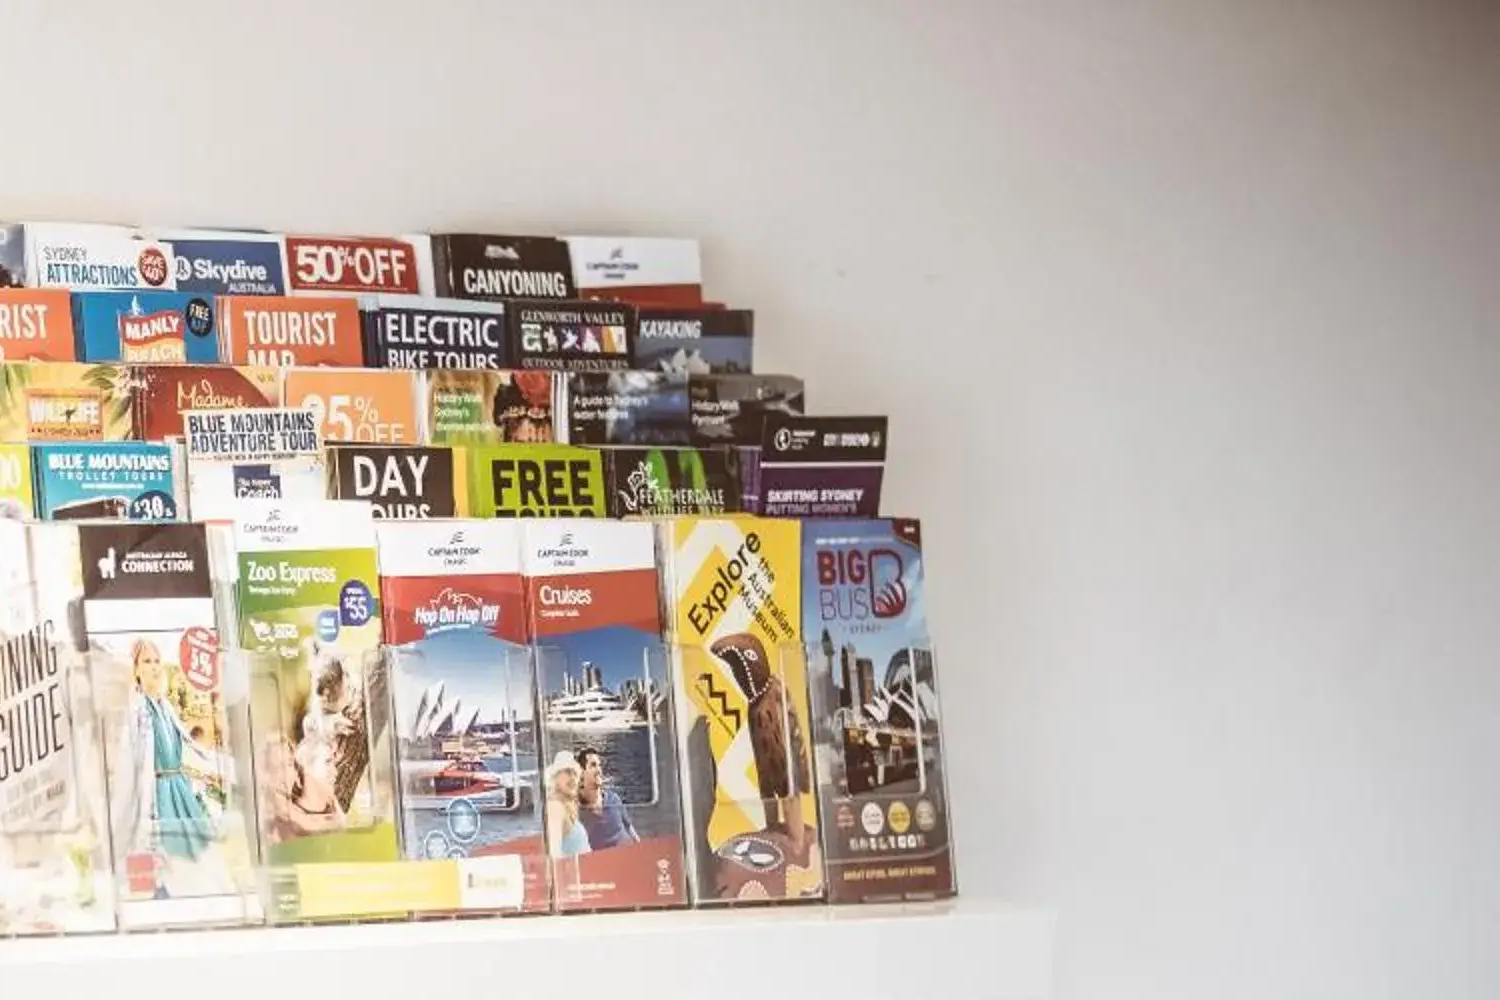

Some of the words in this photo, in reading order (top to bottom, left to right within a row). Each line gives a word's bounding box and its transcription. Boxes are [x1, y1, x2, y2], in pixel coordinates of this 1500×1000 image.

[44, 247, 87, 261] SYDNEY
[47, 264, 137, 286] ATTRACTIONS
[195, 259, 267, 287] Skydive
[355, 248, 406, 285] OFF
[228, 283, 276, 294] AUSTRALIA
[464, 268, 567, 296] CANYONING
[125, 315, 179, 340] MANLY
[244, 310, 337, 345] TOURIST
[521, 311, 581, 324] GLENWORTH
[583, 312, 624, 324] VALLEY
[386, 314, 499, 348] ELECTRIC
[640, 320, 702, 338] KAYAKING
[388, 350, 429, 368] BIKE
[437, 352, 498, 368] TOURS
[189, 415, 225, 434] BLUE
[231, 412, 315, 433] MOUNTAINS
[355, 422, 404, 442] OFF
[191, 433, 276, 452] ADVENTURE
[280, 431, 317, 451] TOUR
[49, 452, 84, 471] BLUE
[88, 453, 170, 471] MOUNTAINS
[353, 455, 429, 497] DAY
[492, 460, 594, 506] FREE
[237, 486, 282, 499] Coach
[639, 488, 724, 504] FEATHERDALE
[820, 489, 863, 502] SYDNEY
[372, 504, 431, 518] OURS
[122, 560, 194, 573] CONNECTION
[247, 561, 277, 580] Zoo
[279, 561, 337, 587] Express
[816, 548, 867, 586] BIG
[688, 530, 762, 636] Explore
[539, 585, 592, 606] Cruises
[819, 587, 870, 622] BUS
[415, 607, 439, 625] Hop
[439, 607, 455, 623] On
[456, 606, 480, 624] Hop
[737, 586, 779, 644] Museum
[748, 574, 796, 640] Australian
